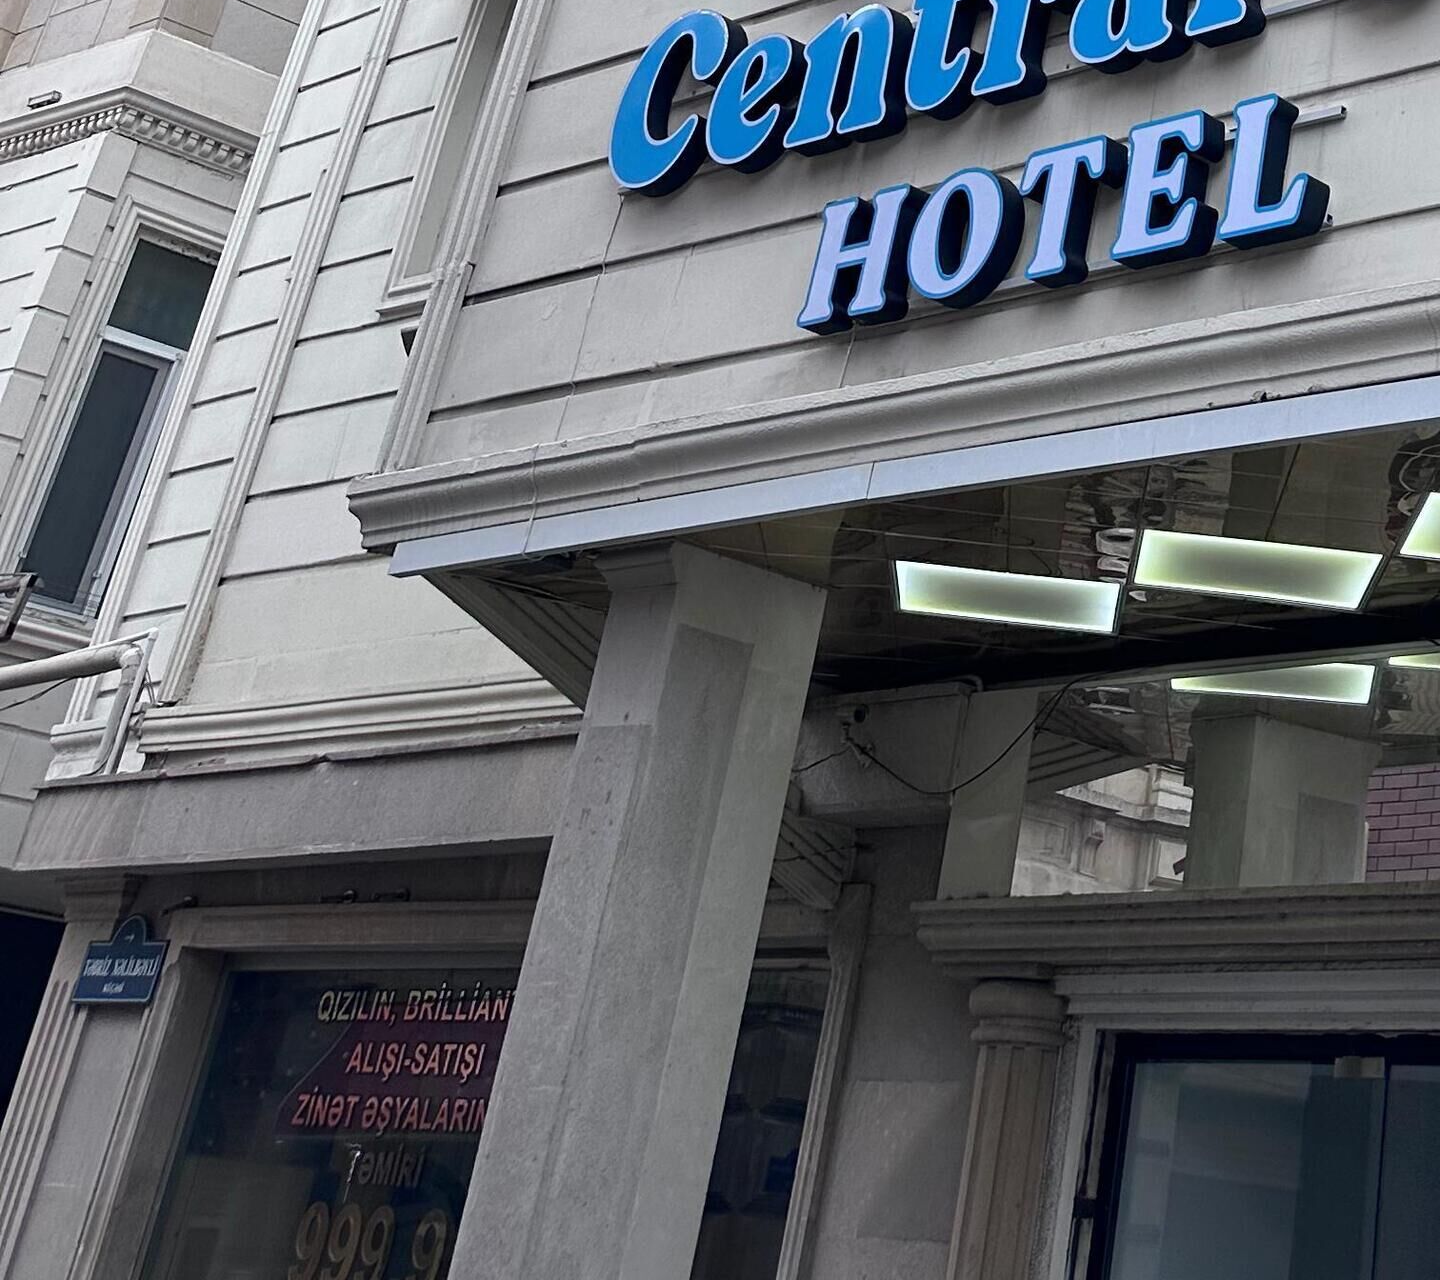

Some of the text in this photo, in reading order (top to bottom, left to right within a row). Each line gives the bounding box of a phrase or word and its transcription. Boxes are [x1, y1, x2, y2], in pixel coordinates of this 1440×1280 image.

[796, 92, 1316, 332] HOTEL
[317, 981, 518, 1027] QIZILIN, BRİLLİAN
[344, 1042, 487, 1083] ALIŞI-SATIŞI
[291, 1087, 360, 1128] ZİNƏT
